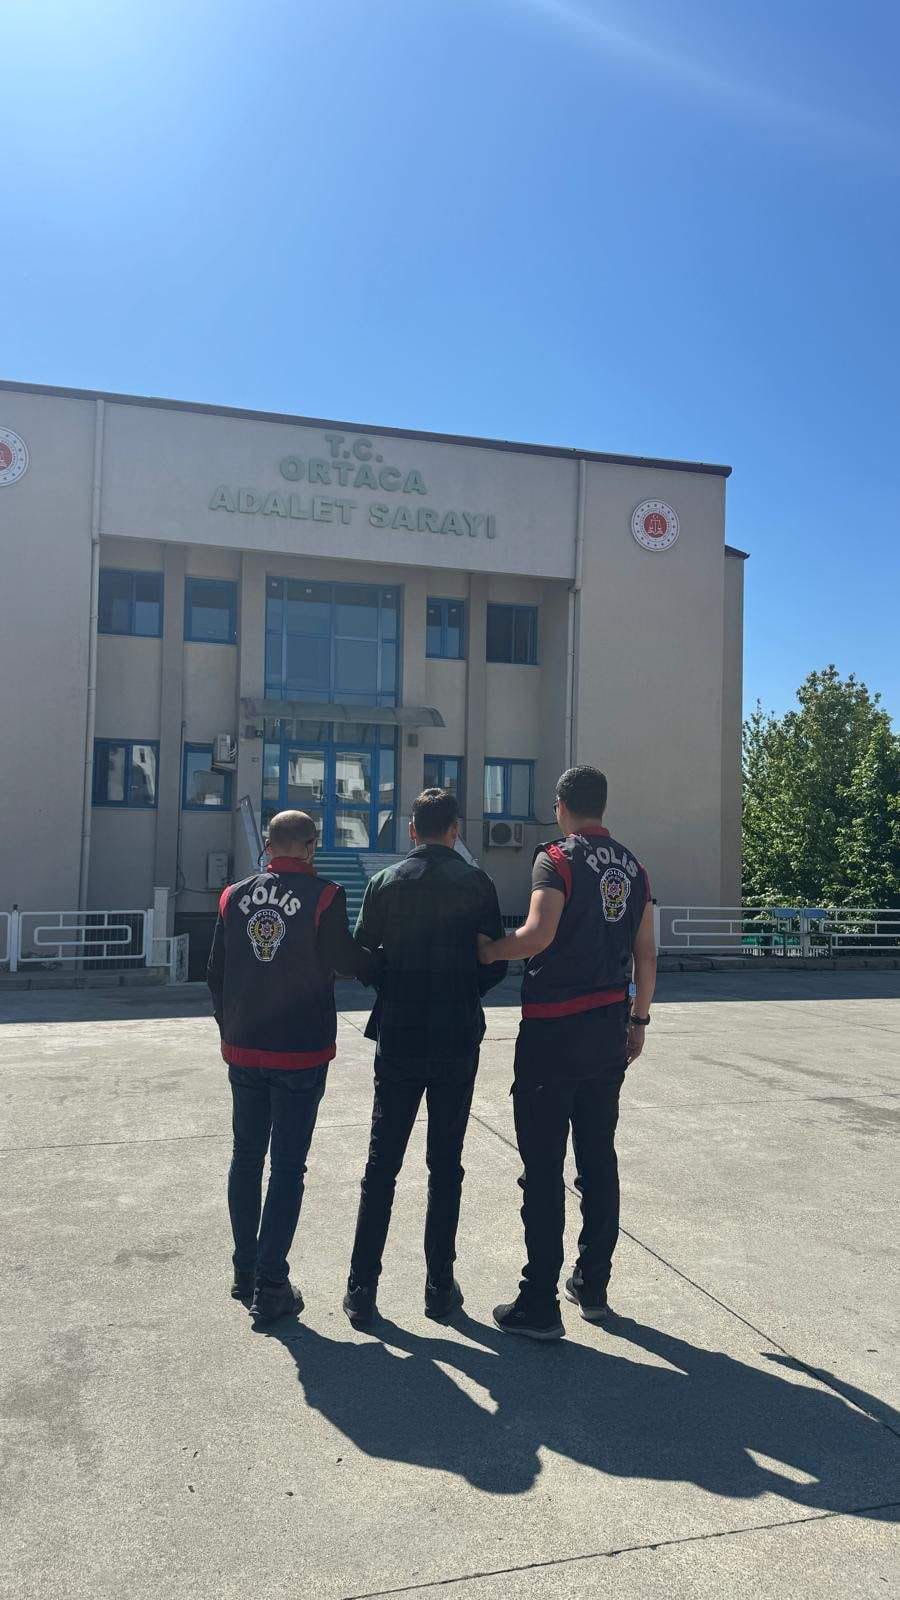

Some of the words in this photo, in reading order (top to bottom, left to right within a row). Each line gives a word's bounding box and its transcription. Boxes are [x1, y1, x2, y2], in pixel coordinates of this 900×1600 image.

[325, 434, 383, 463] T.C.
[279, 455, 427, 495] ORTACA
[208, 485, 357, 525] ADALET
[368, 502, 496, 539] SARAYI
